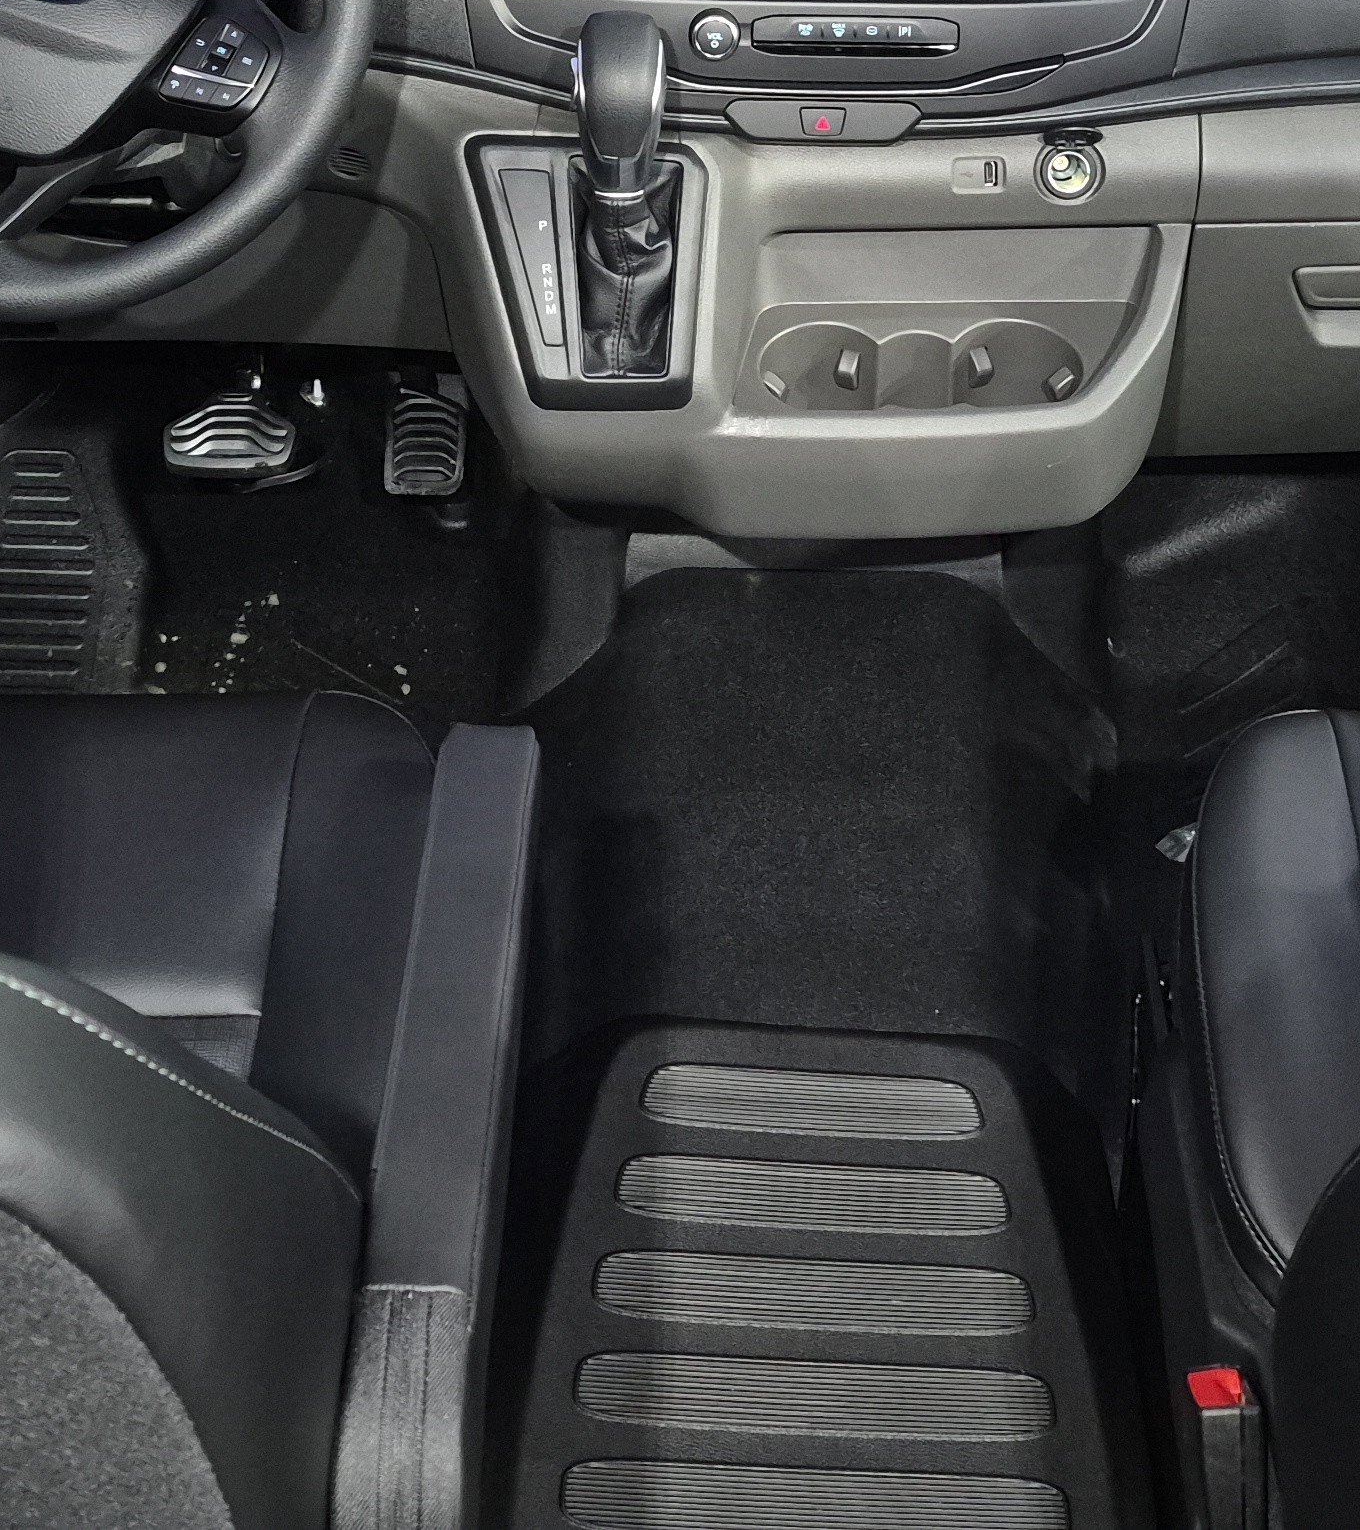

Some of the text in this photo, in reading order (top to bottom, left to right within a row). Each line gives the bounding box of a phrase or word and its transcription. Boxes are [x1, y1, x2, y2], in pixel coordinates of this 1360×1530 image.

[707, 32, 723, 41] VOL
[538, 220, 548, 231] P
[541, 263, 552, 275] R
[543, 276, 553, 288] N
[544, 290, 554, 302] D
[545, 303, 557, 315] M
